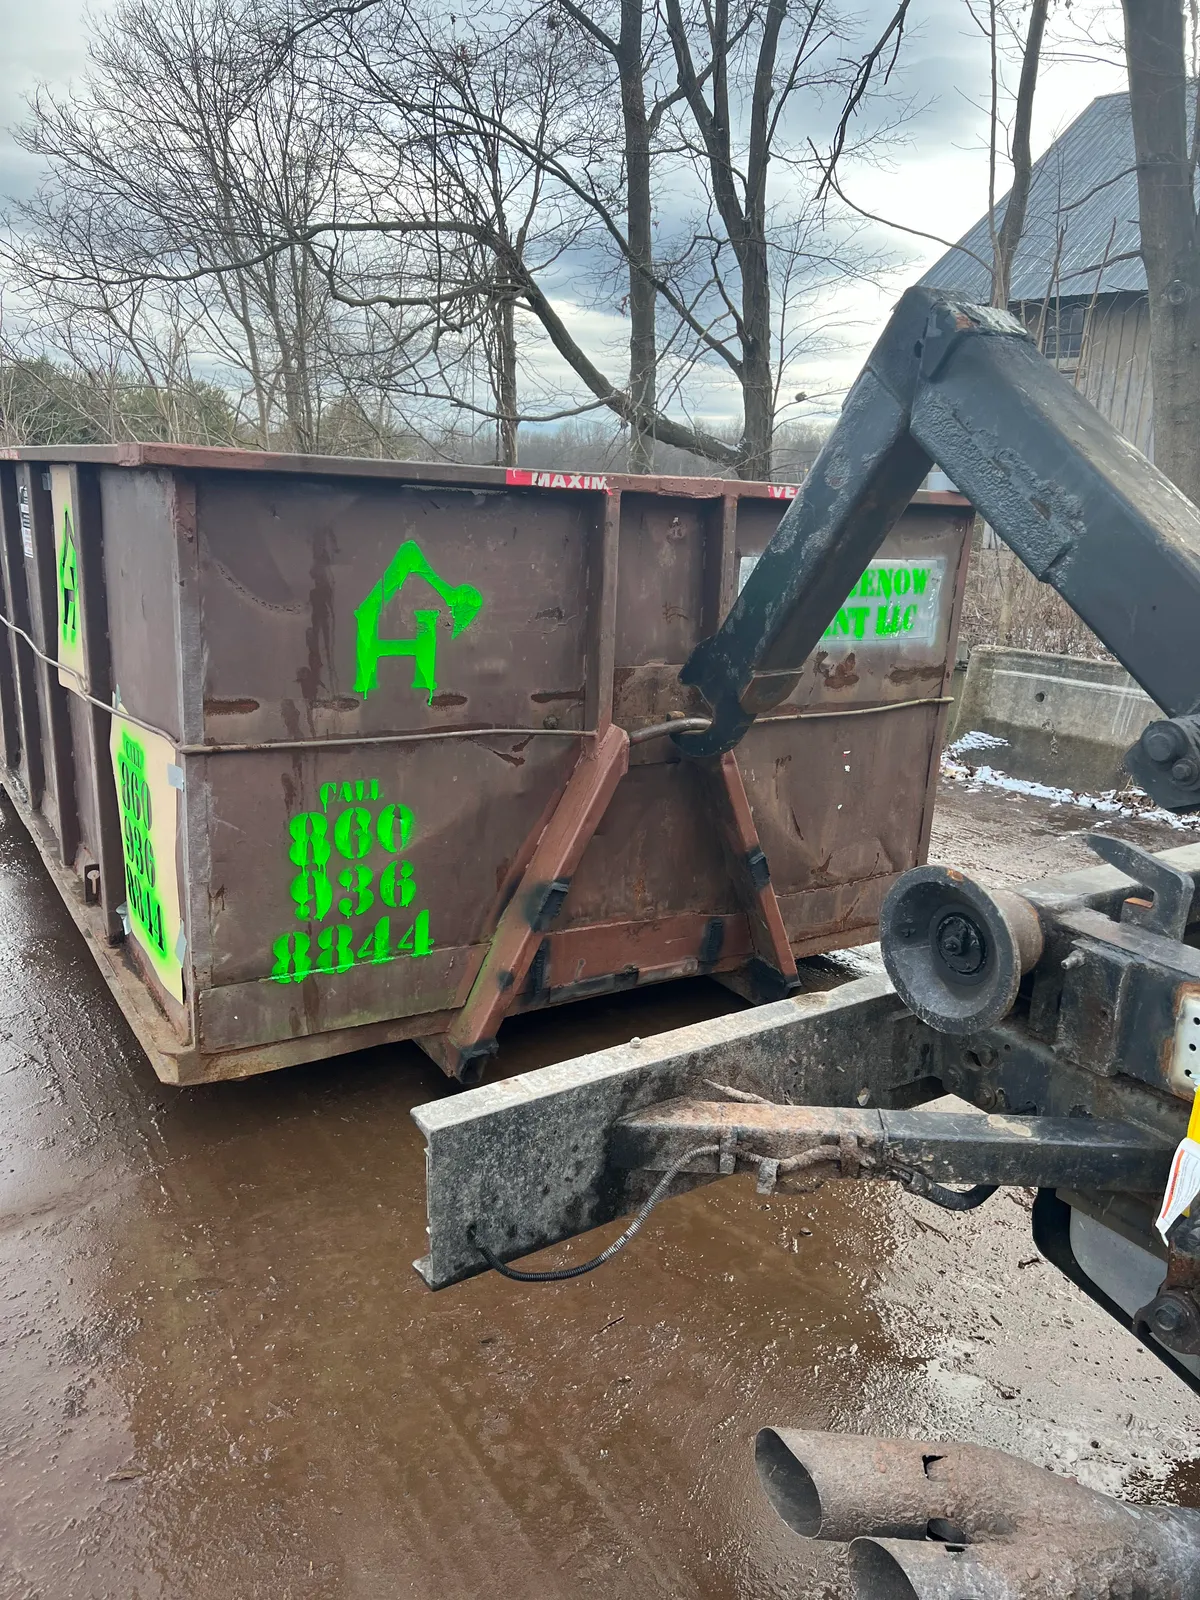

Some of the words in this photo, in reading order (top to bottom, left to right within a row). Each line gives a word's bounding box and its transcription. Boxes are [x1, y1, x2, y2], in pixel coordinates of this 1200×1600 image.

[531, 472, 608, 490] MAXIM
[849, 567, 931, 600] ENOW
[823, 606, 870, 640] NT
[875, 603, 918, 636] LLC
[125, 739, 142, 770] CALL
[121, 760, 153, 832] 860
[319, 778, 384, 806] CALL
[124, 815, 156, 888] 936
[289, 803, 415, 866] 860
[290, 860, 417, 921] 936
[272, 909, 435, 983] 8844
